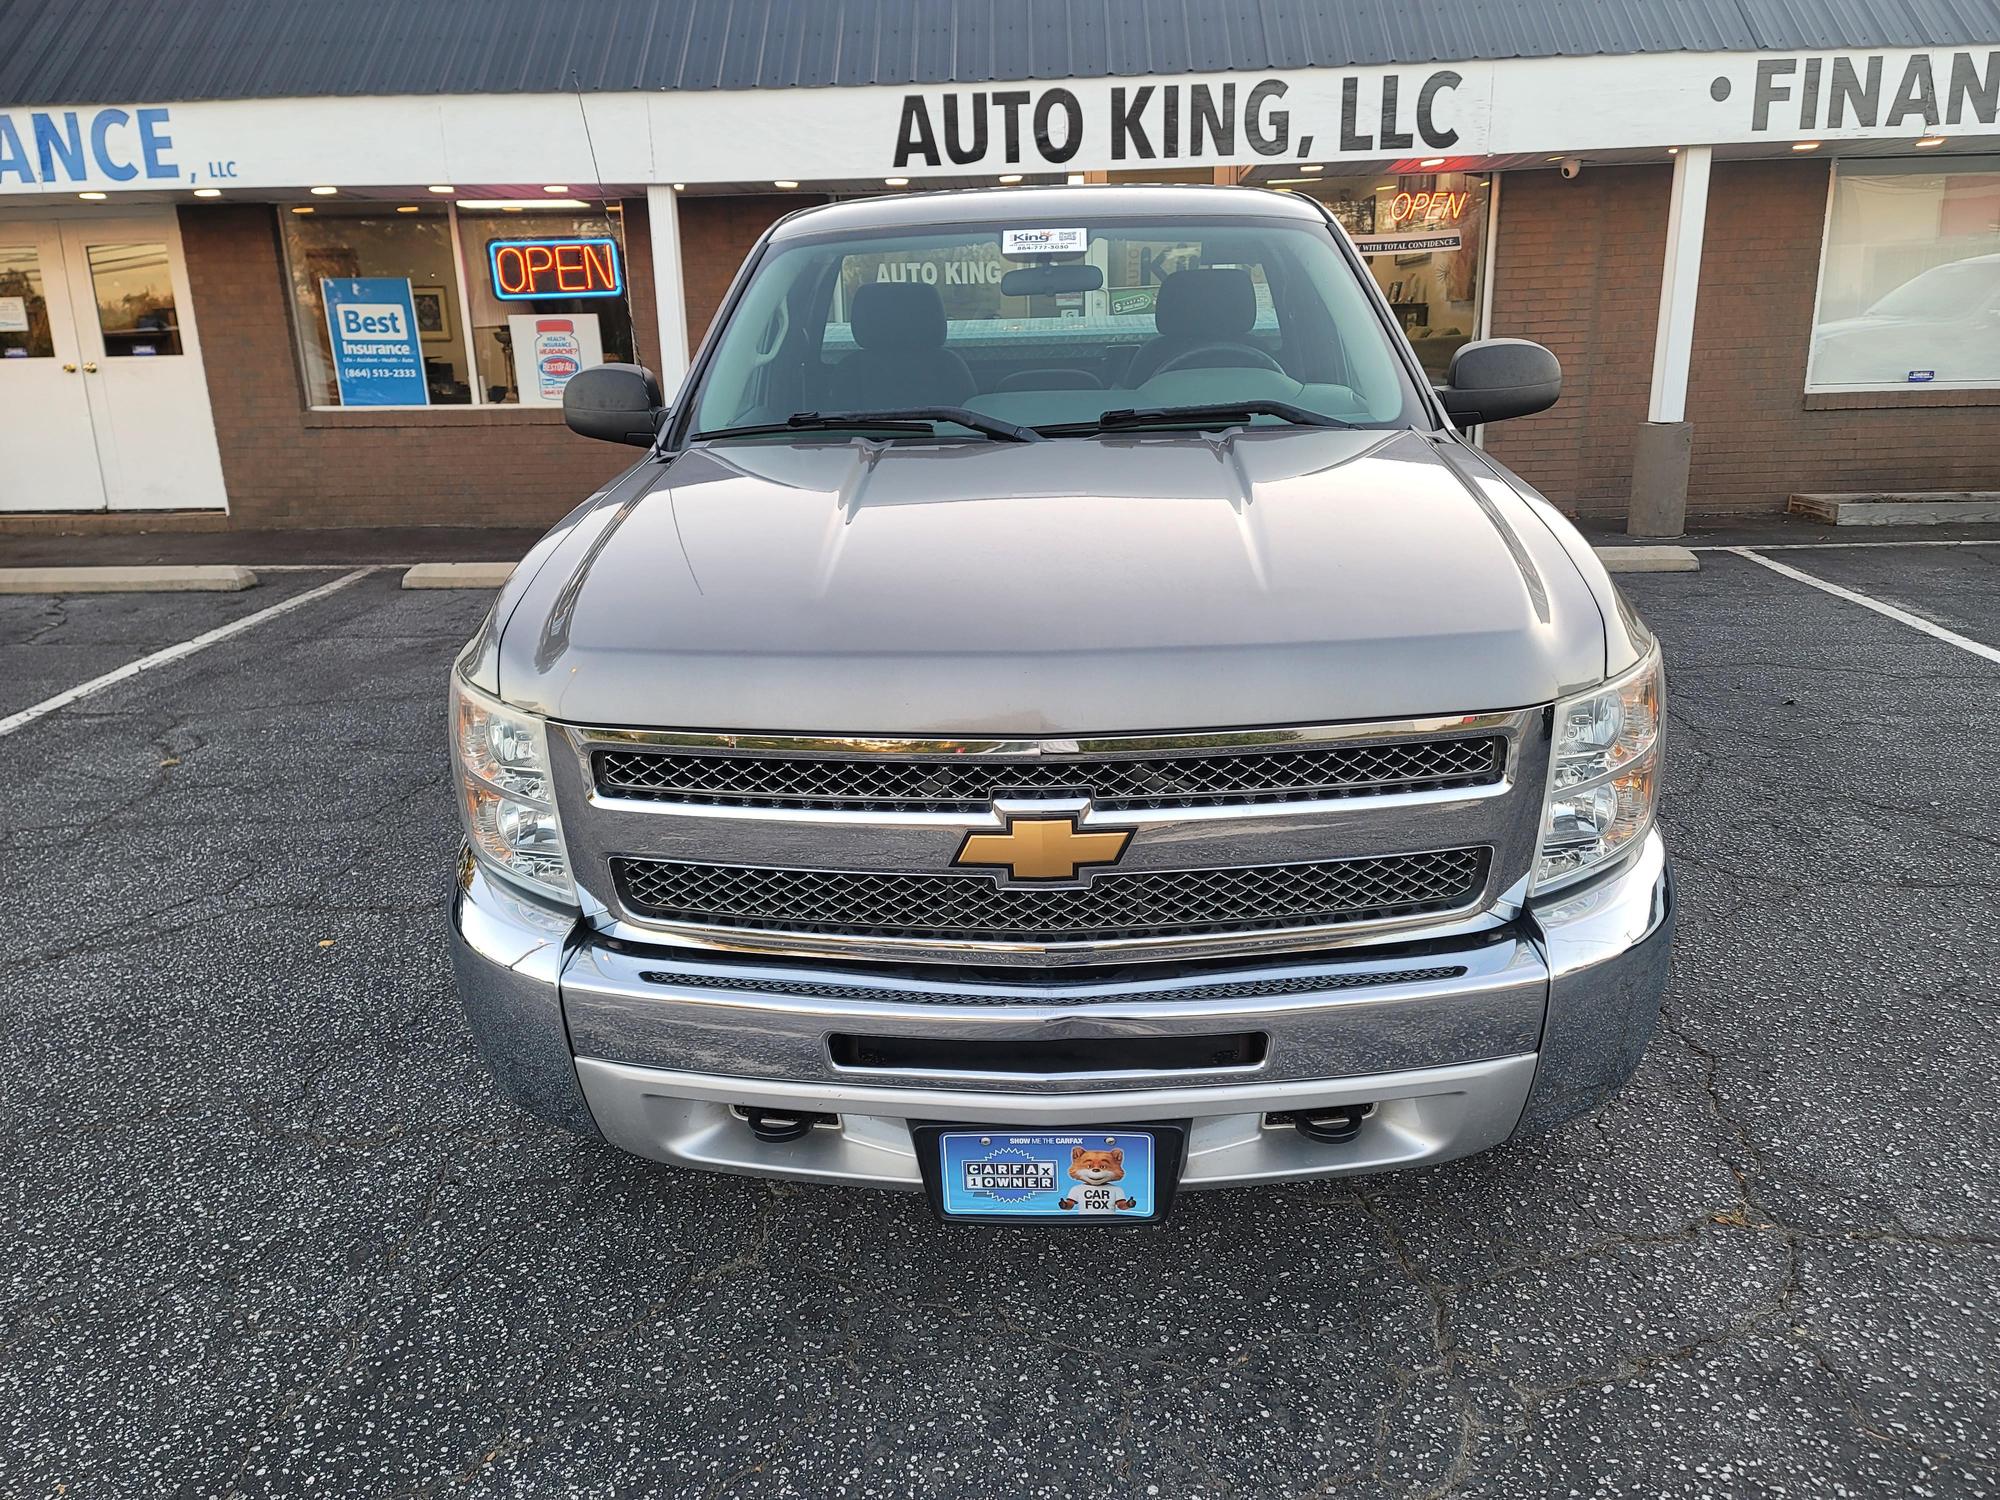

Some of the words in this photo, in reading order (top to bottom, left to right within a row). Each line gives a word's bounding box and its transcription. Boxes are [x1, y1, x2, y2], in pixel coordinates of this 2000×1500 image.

[1751, 52, 2000, 132] FINAN
[893, 86, 1084, 168] AUTO
[1110, 79, 1315, 161] KING,
[1339, 70, 1463, 153] LLC
[208, 161, 239, 178] LLC
[1391, 192, 1468, 221] OPEN
[1013, 233, 1049, 243] King
[1362, 244, 1382, 252] WITH
[1383, 243, 1407, 251] TOTAL
[1408, 238, 1457, 249] CONFIDENCE.
[496, 246, 614, 292] OPEN
[876, 262, 939, 286] AUTO
[944, 260, 1001, 285] KING
[343, 310, 401, 333] Best
[342, 341, 410, 355] Insurance
[345, 367, 371, 379] (864)
[372, 368, 416, 378] 513-2333
[1009, 1137, 1031, 1145] SHOW
[1031, 1137, 1041, 1145] ME
[1042, 1137, 1055, 1145] THE
[1055, 1137, 1083, 1145] CARFAX
[969, 1164, 1051, 1176] CARFAX
[983, 1177, 1051, 1187] OWNER
[1083, 1189, 1110, 1200] CAR
[1085, 1199, 1109, 1210] FOX
